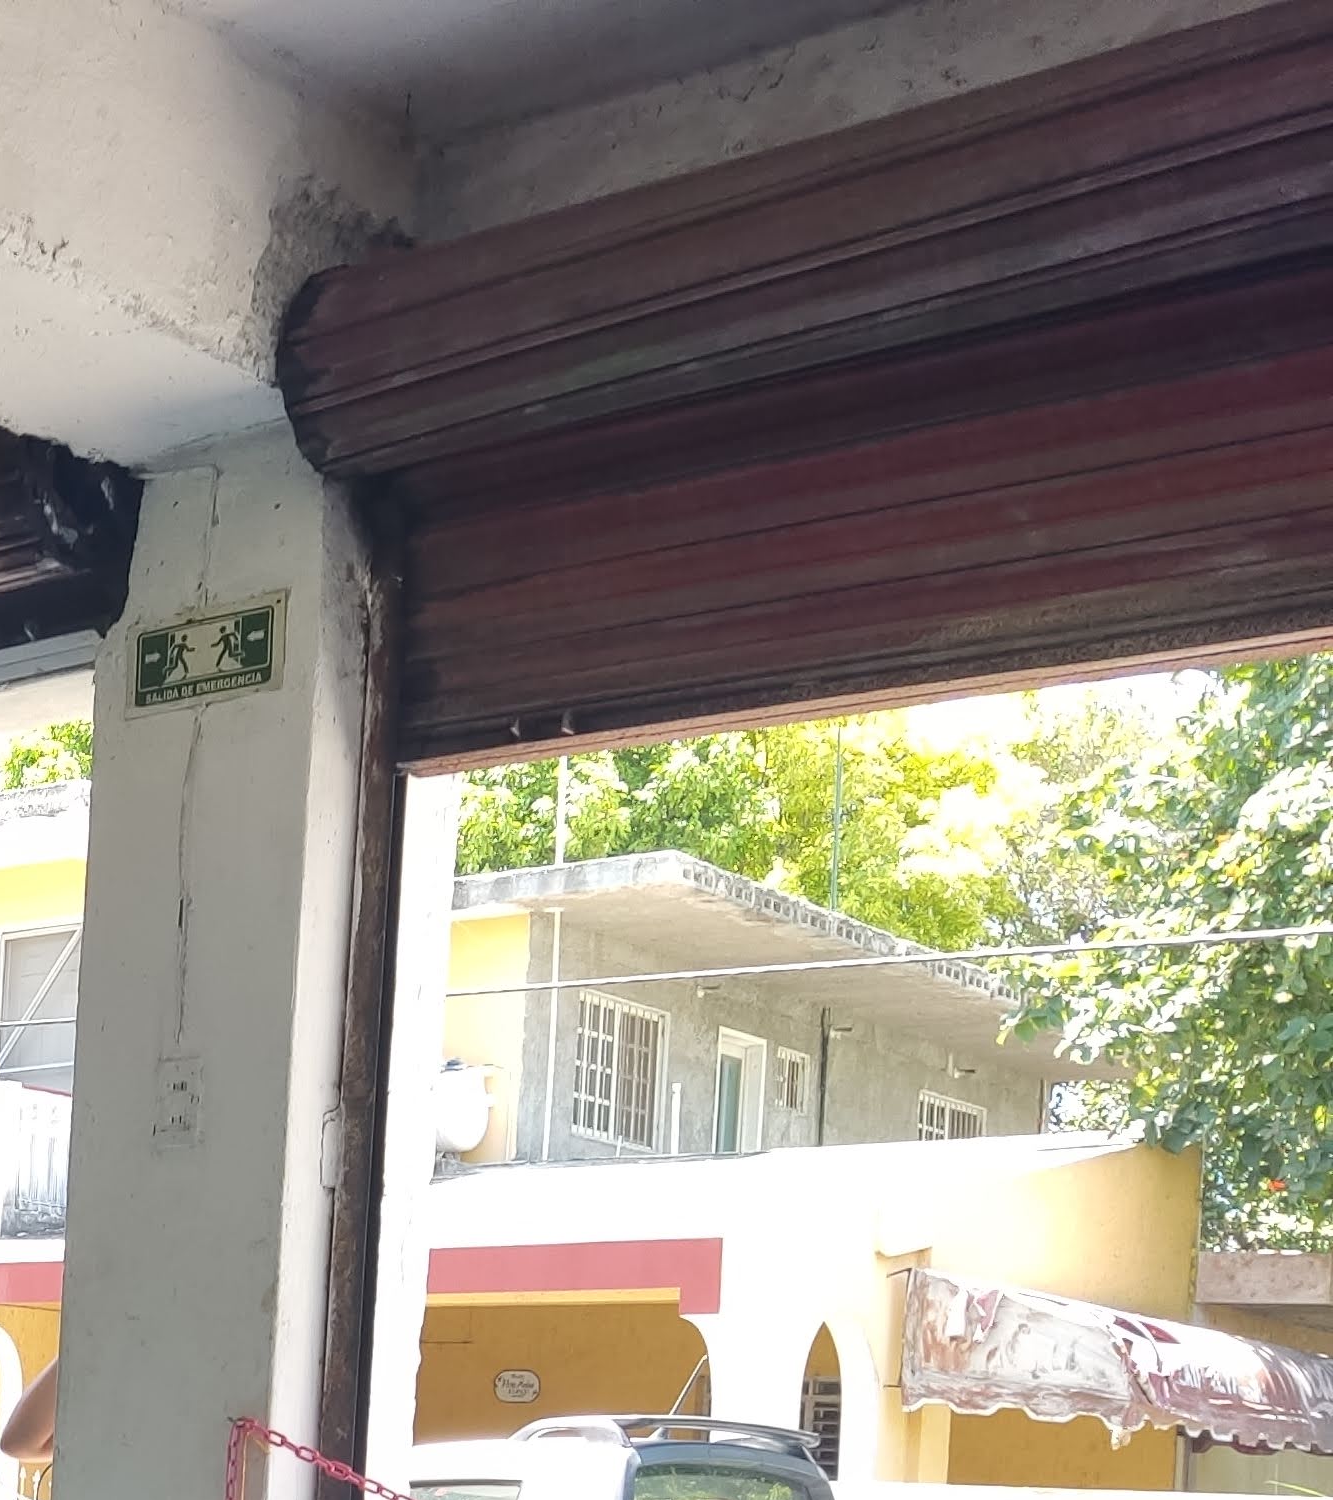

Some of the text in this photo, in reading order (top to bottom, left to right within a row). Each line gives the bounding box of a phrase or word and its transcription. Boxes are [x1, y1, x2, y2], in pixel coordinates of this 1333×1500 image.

[145, 672, 263, 705] SALIDA DE EMERGENCIA
